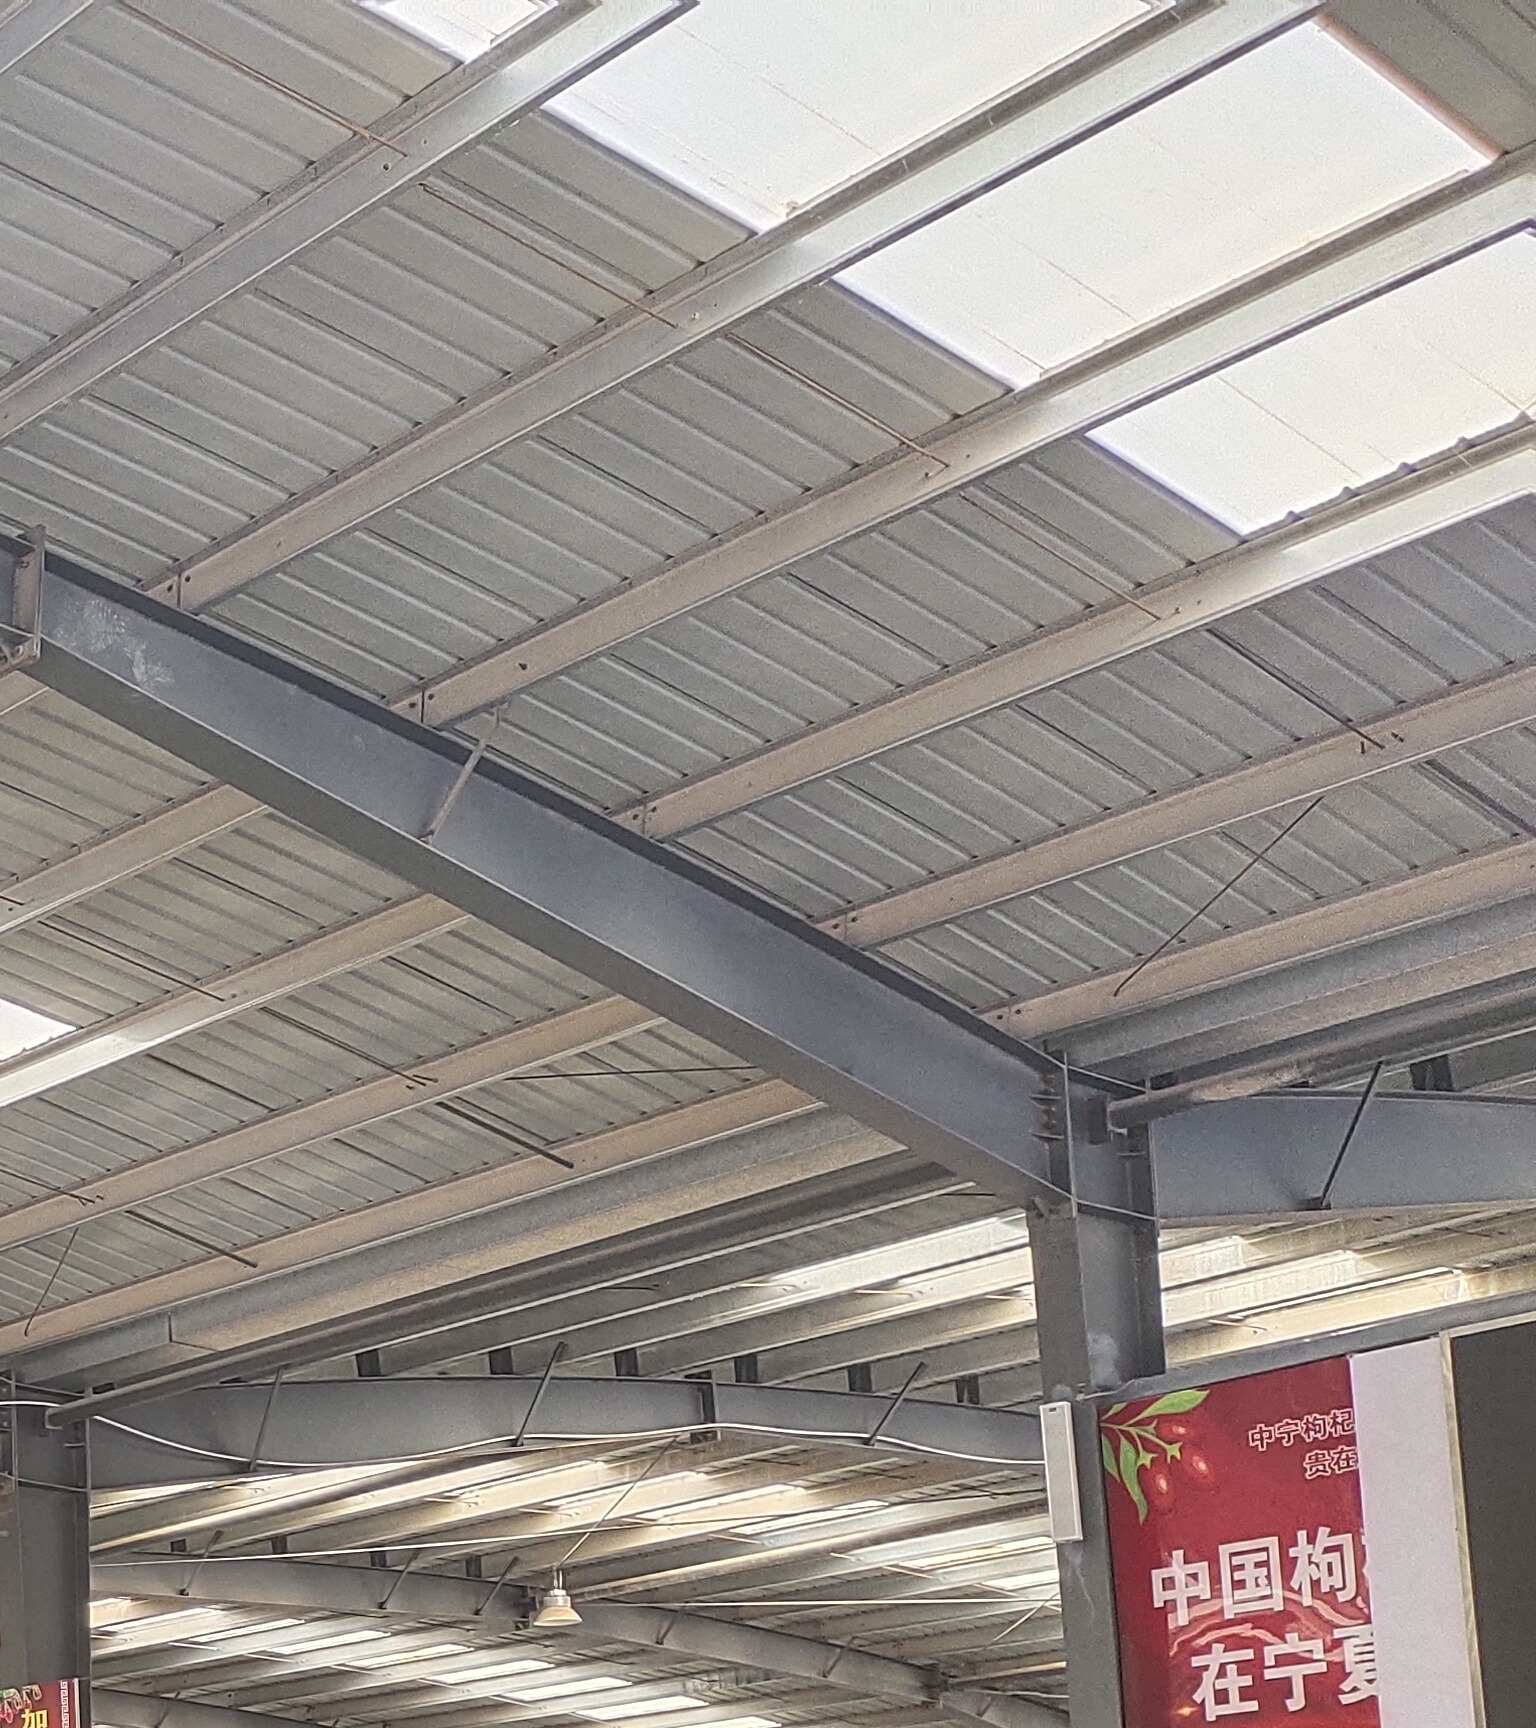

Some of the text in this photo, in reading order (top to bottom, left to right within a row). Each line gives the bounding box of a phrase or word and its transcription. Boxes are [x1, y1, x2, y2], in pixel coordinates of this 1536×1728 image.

[1249, 1408, 1355, 1452] 中宁枸杞
[1150, 1526, 1371, 1630] 中国枸
[1190, 1623, 1379, 1722] 在宁夏
